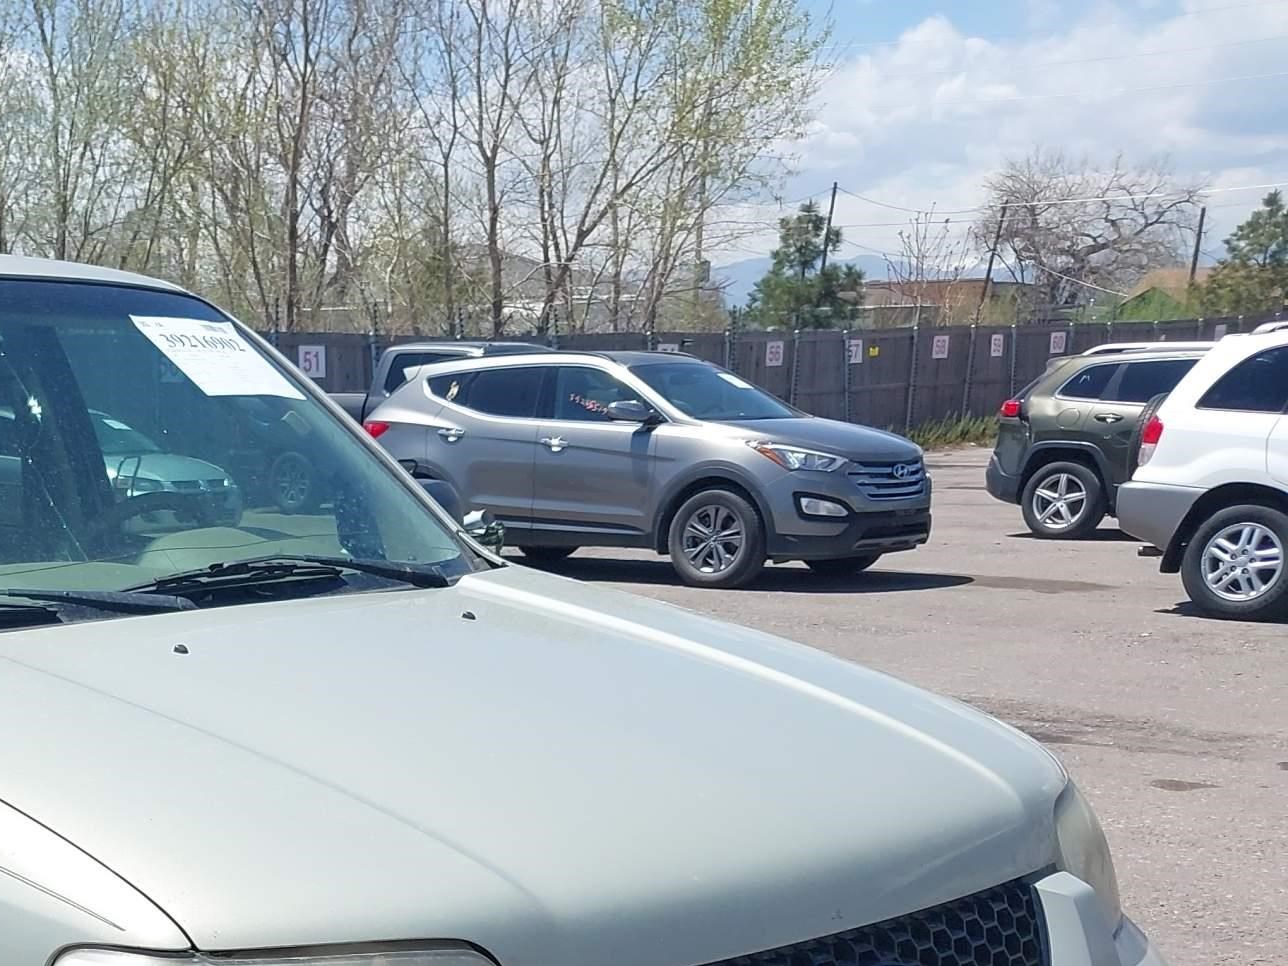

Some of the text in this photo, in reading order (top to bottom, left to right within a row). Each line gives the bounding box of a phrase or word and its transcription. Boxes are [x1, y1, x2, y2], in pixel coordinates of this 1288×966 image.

[159, 333, 246, 352] 39216902
[303, 351, 320, 372] 51
[768, 345, 781, 362] 56
